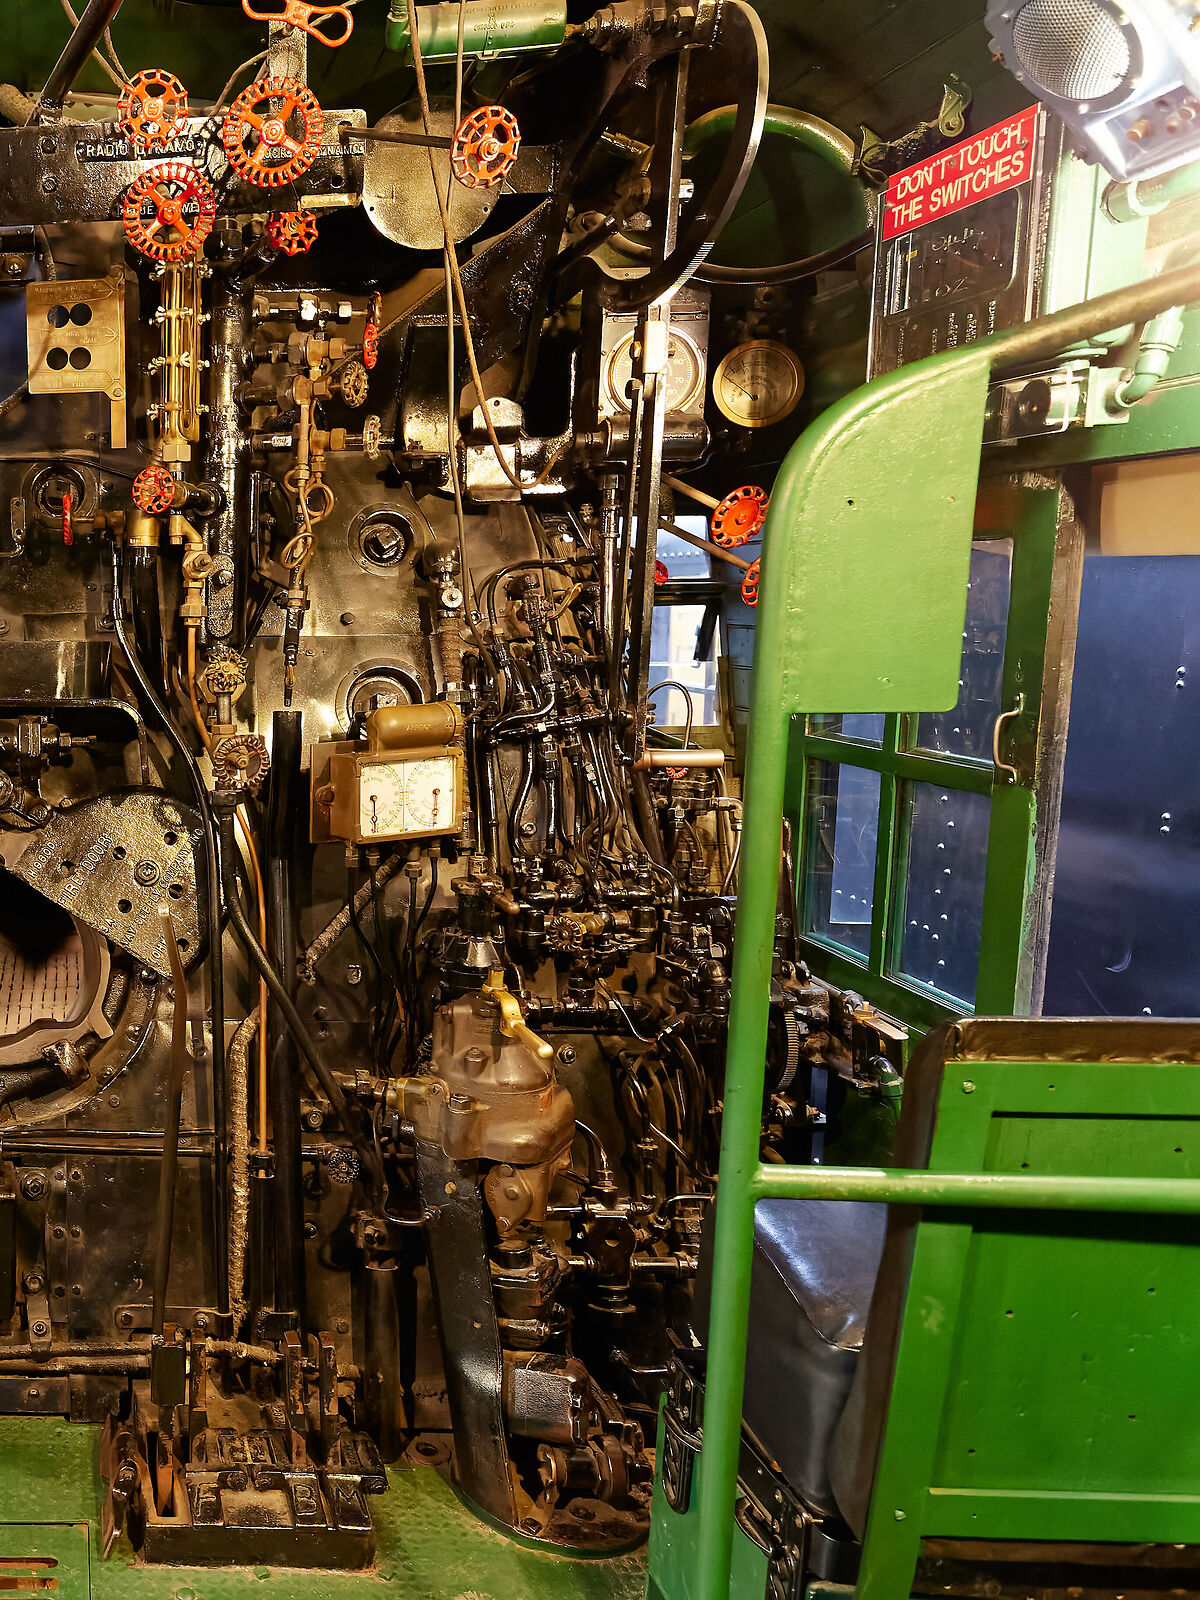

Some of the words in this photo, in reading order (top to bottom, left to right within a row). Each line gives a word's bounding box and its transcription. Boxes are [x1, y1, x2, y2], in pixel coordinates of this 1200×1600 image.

[86, 143, 128, 157] RADIO
[959, 119, 1025, 171] TOUCH
[891, 195, 924, 229] THE
[929, 150, 1025, 212] SWITCHES
[57, 875, 84, 908] FIRE
[80, 834, 113, 875] DOOR
[195, 1482, 220, 1517] F
[293, 1484, 318, 1516] B
[335, 1484, 369, 1519] M
